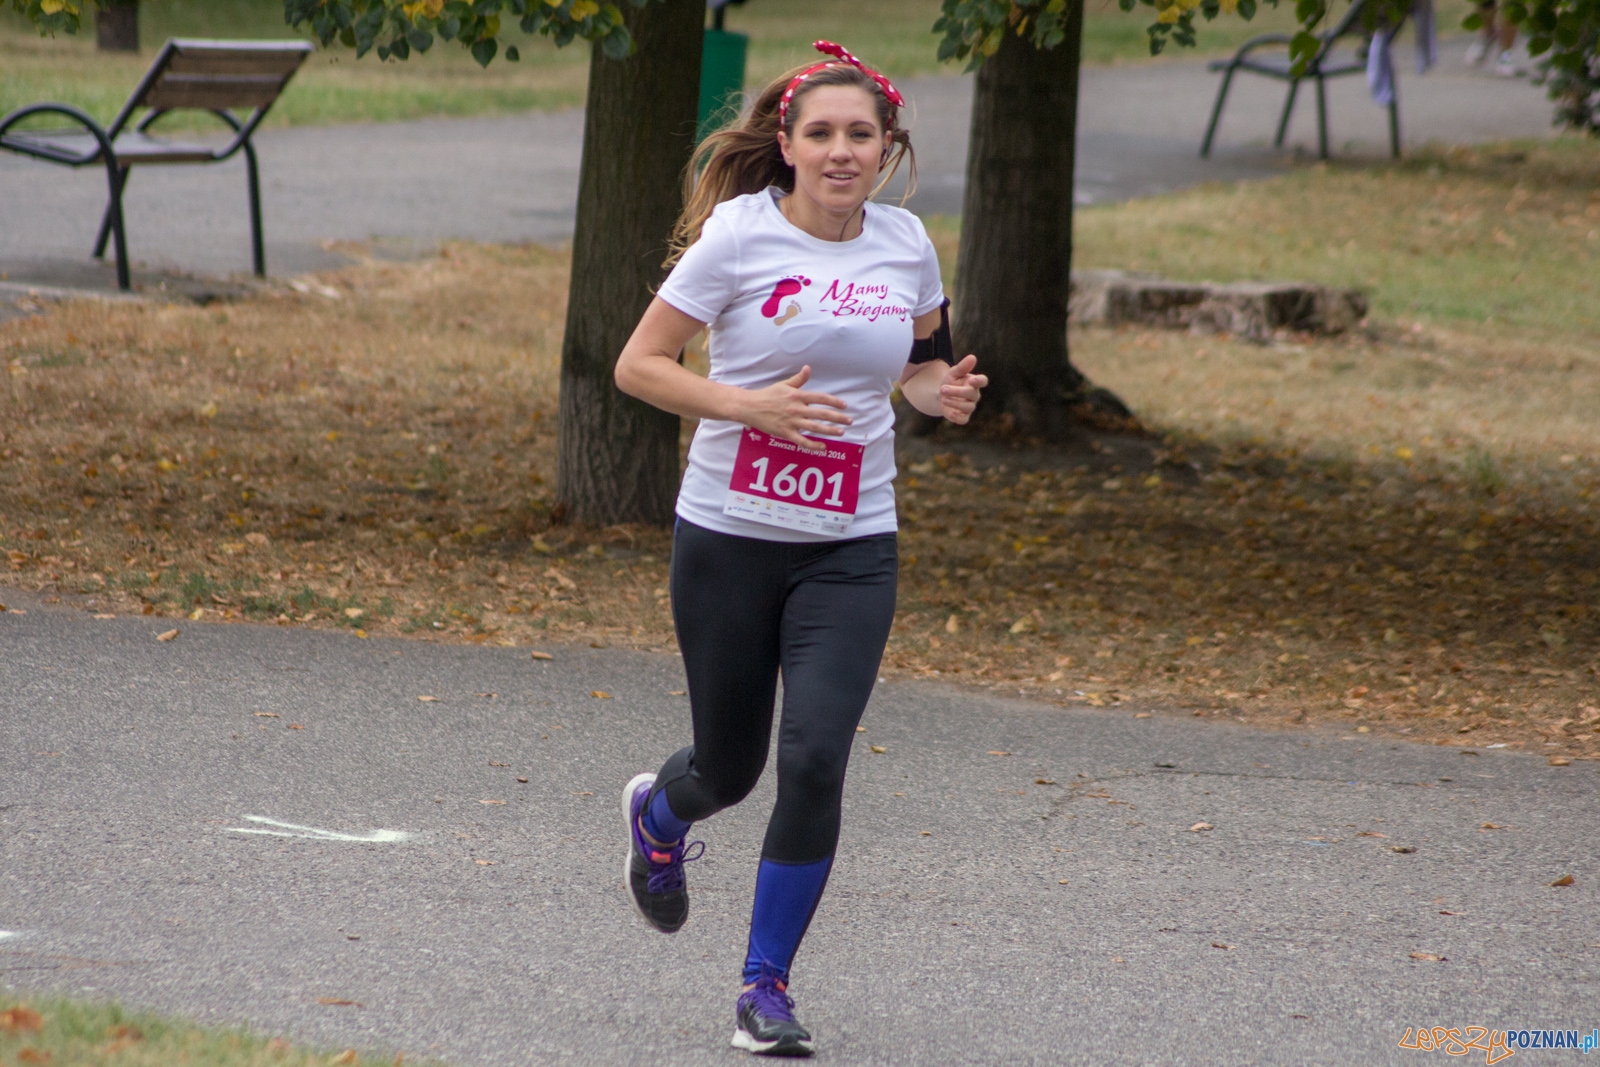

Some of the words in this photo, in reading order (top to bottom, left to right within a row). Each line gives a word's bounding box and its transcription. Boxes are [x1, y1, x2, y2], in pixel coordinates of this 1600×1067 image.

[819, 279, 889, 303] Mamy
[831, 298, 907, 322] Biegamy
[768, 438, 796, 451] Zawsze
[827, 451, 846, 461] 2016
[748, 456, 844, 507] 1601
